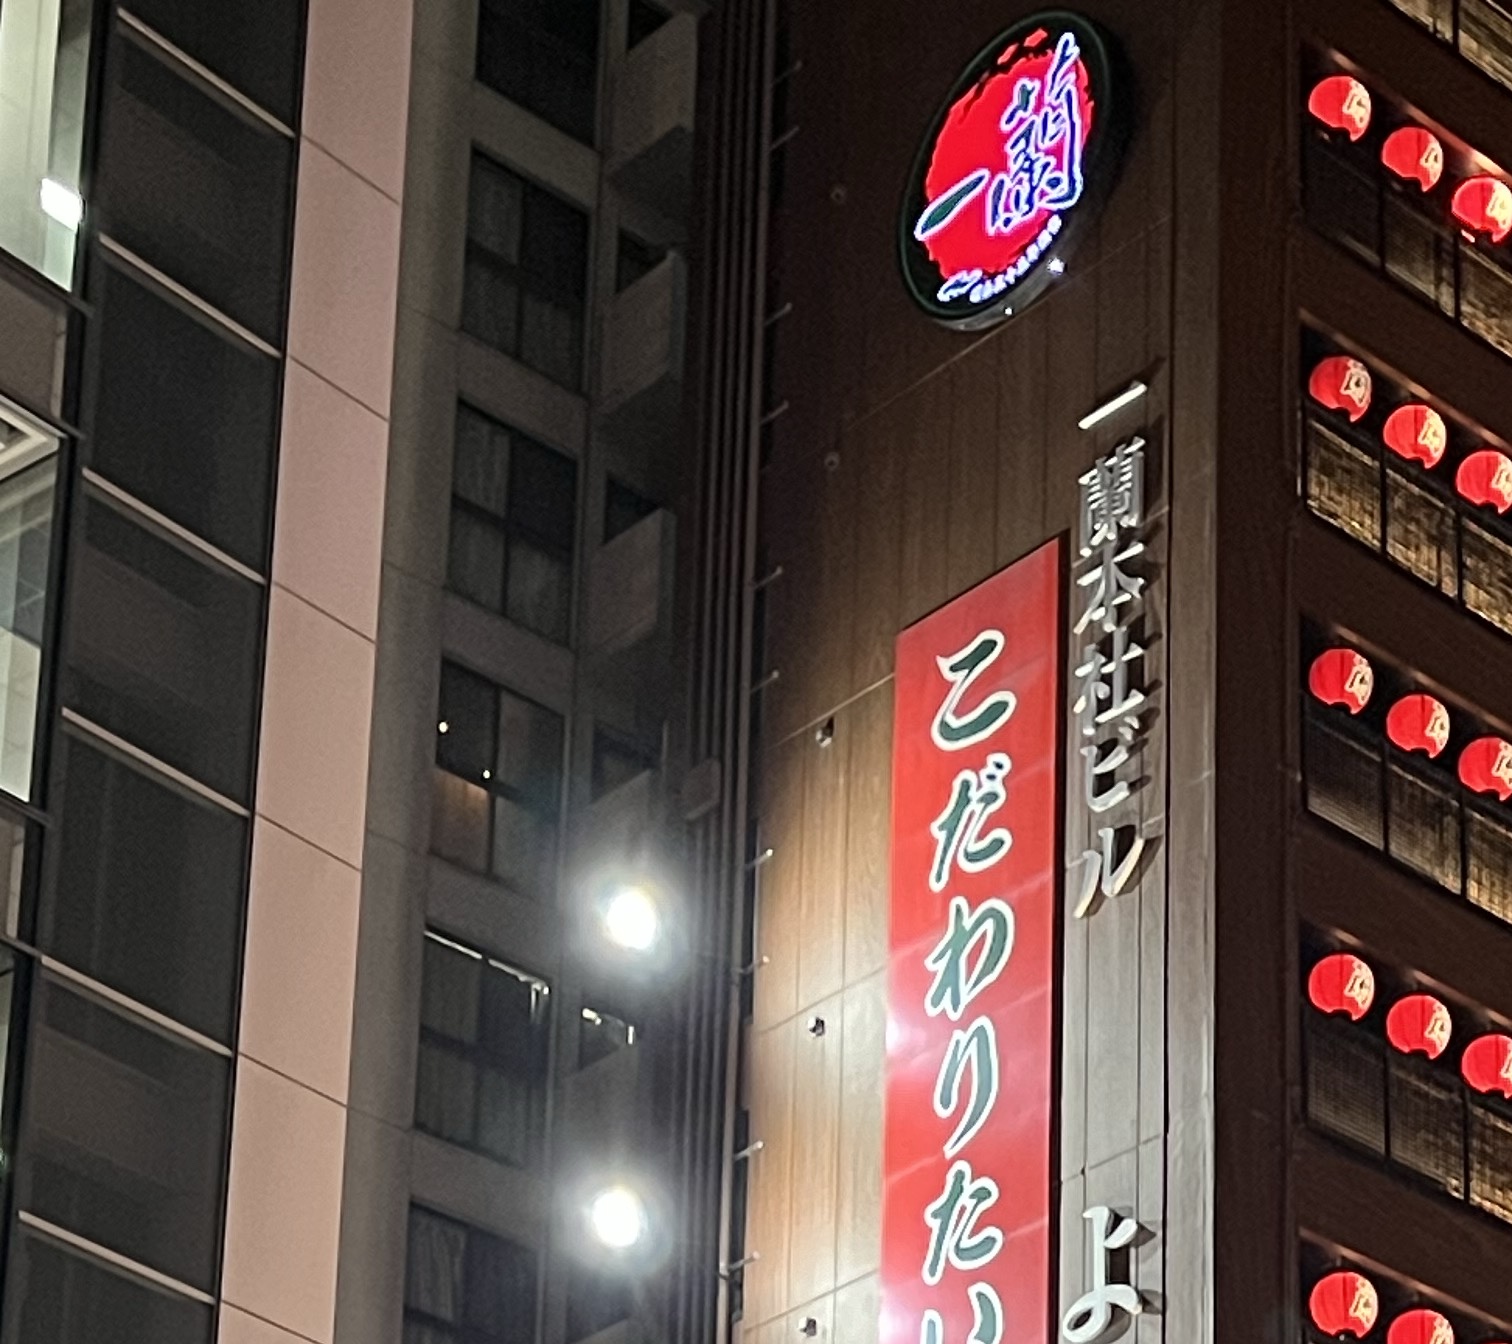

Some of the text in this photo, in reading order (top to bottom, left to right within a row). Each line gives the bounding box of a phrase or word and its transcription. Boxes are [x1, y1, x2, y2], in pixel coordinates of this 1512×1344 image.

[1073, 382, 1148, 920] 一蘭本社ビル
